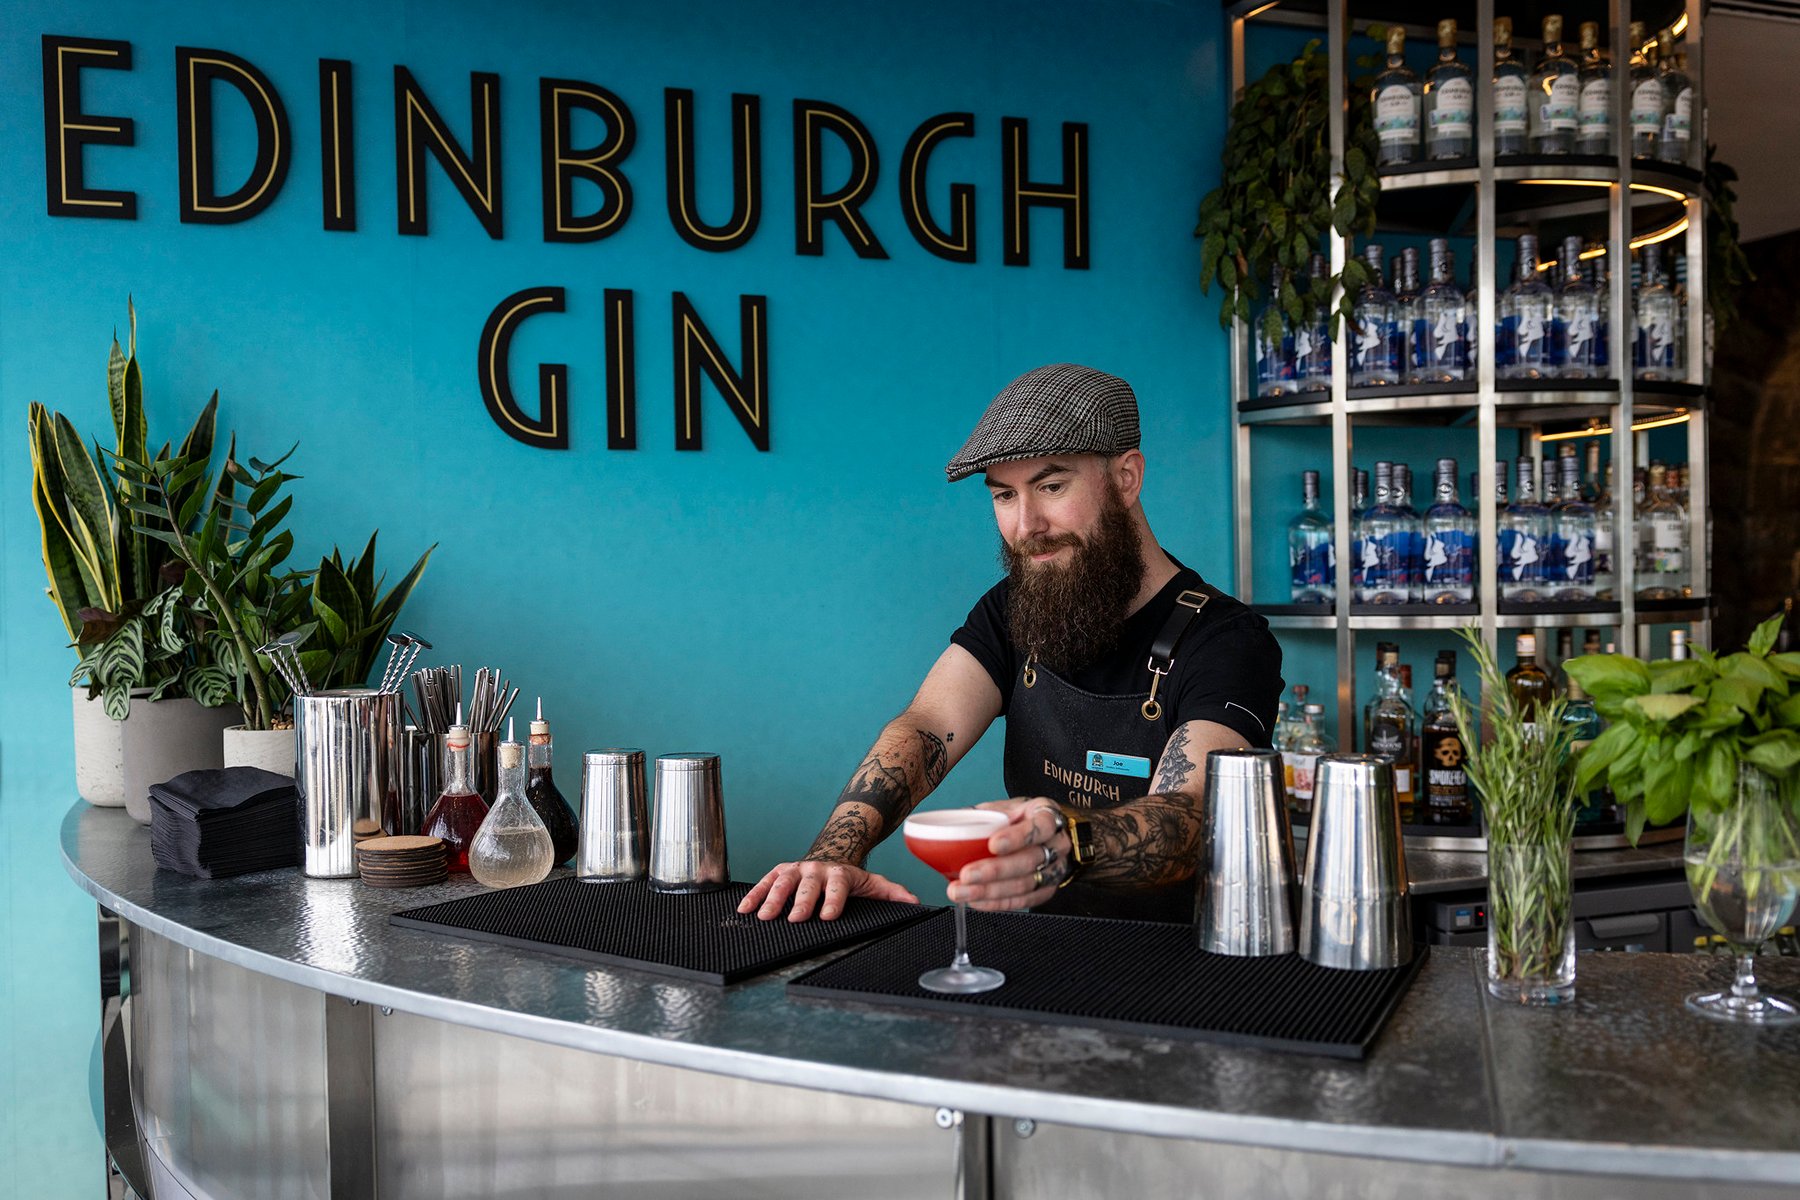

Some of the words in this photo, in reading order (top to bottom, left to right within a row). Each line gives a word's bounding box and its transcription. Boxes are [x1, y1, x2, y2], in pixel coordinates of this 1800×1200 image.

[42, 34, 1090, 270] EDINBURGH
[478, 286, 770, 452] GIN
[1044, 760, 1119, 801] EDINBURGH
[1069, 791, 1091, 808] GIN
